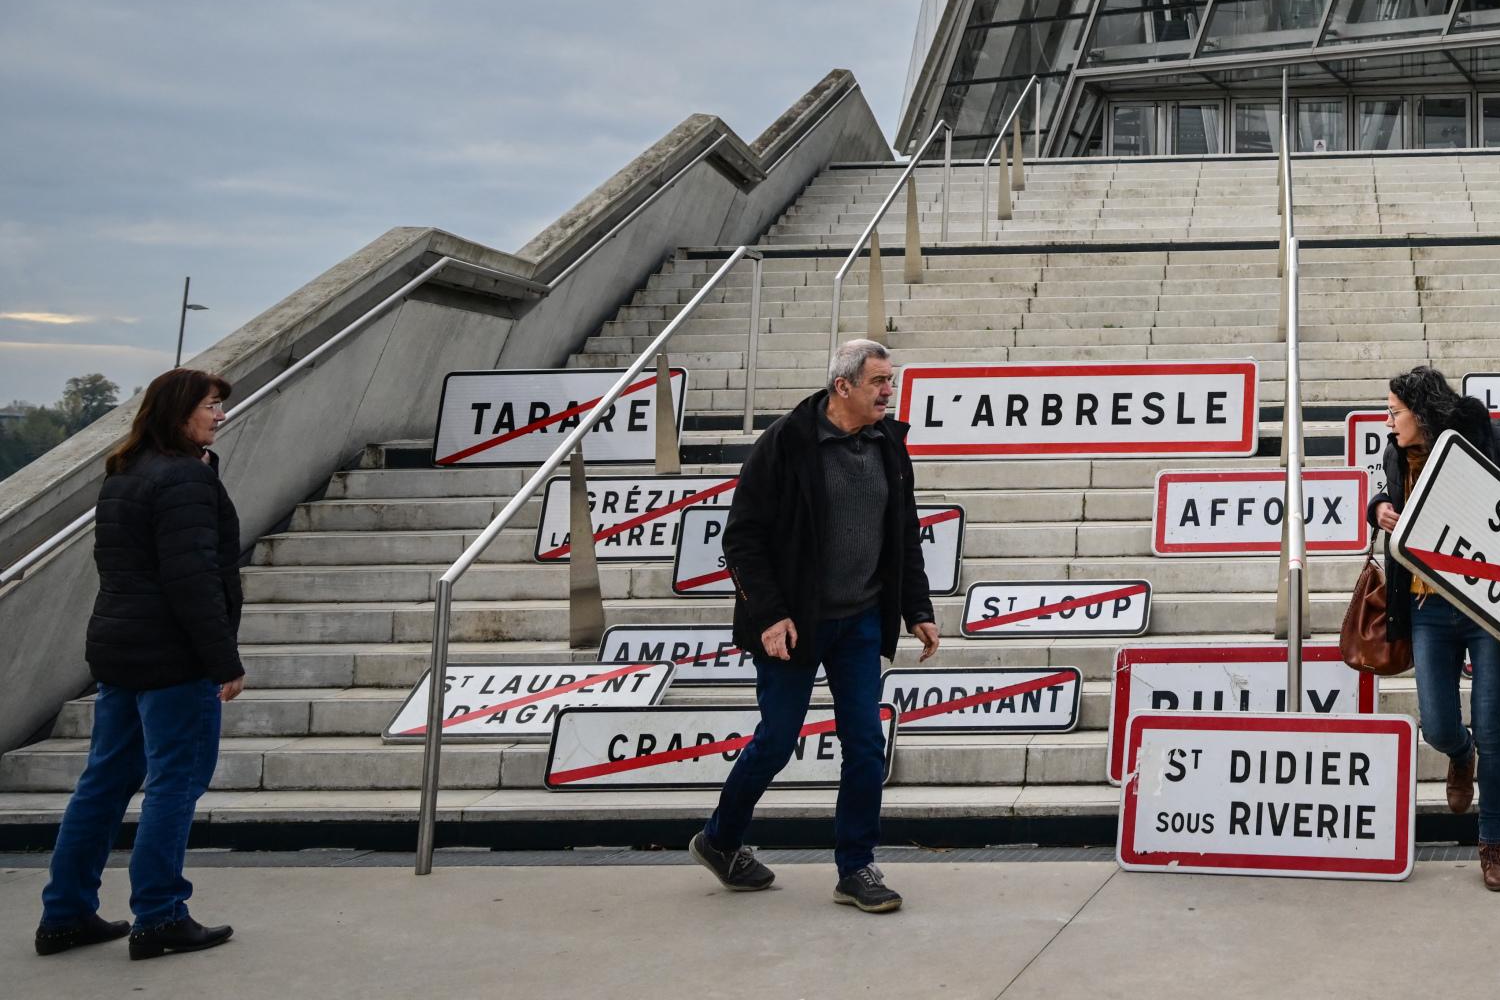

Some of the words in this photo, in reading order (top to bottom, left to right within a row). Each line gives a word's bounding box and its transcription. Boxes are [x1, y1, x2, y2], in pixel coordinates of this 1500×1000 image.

[924, 391, 1228, 428] L'ARBRESLE
[981, 596, 1018, 620] ST
[1037, 595, 1132, 620] LOUP
[479, 673, 652, 695] LAURENT
[893, 685, 1065, 715] MORNANT
[1165, 748, 1203, 783] ST
[1229, 749, 1371, 786] DIDIER
[1155, 811, 1215, 834] SOUS
[1229, 800, 1376, 840] RIVERIE
